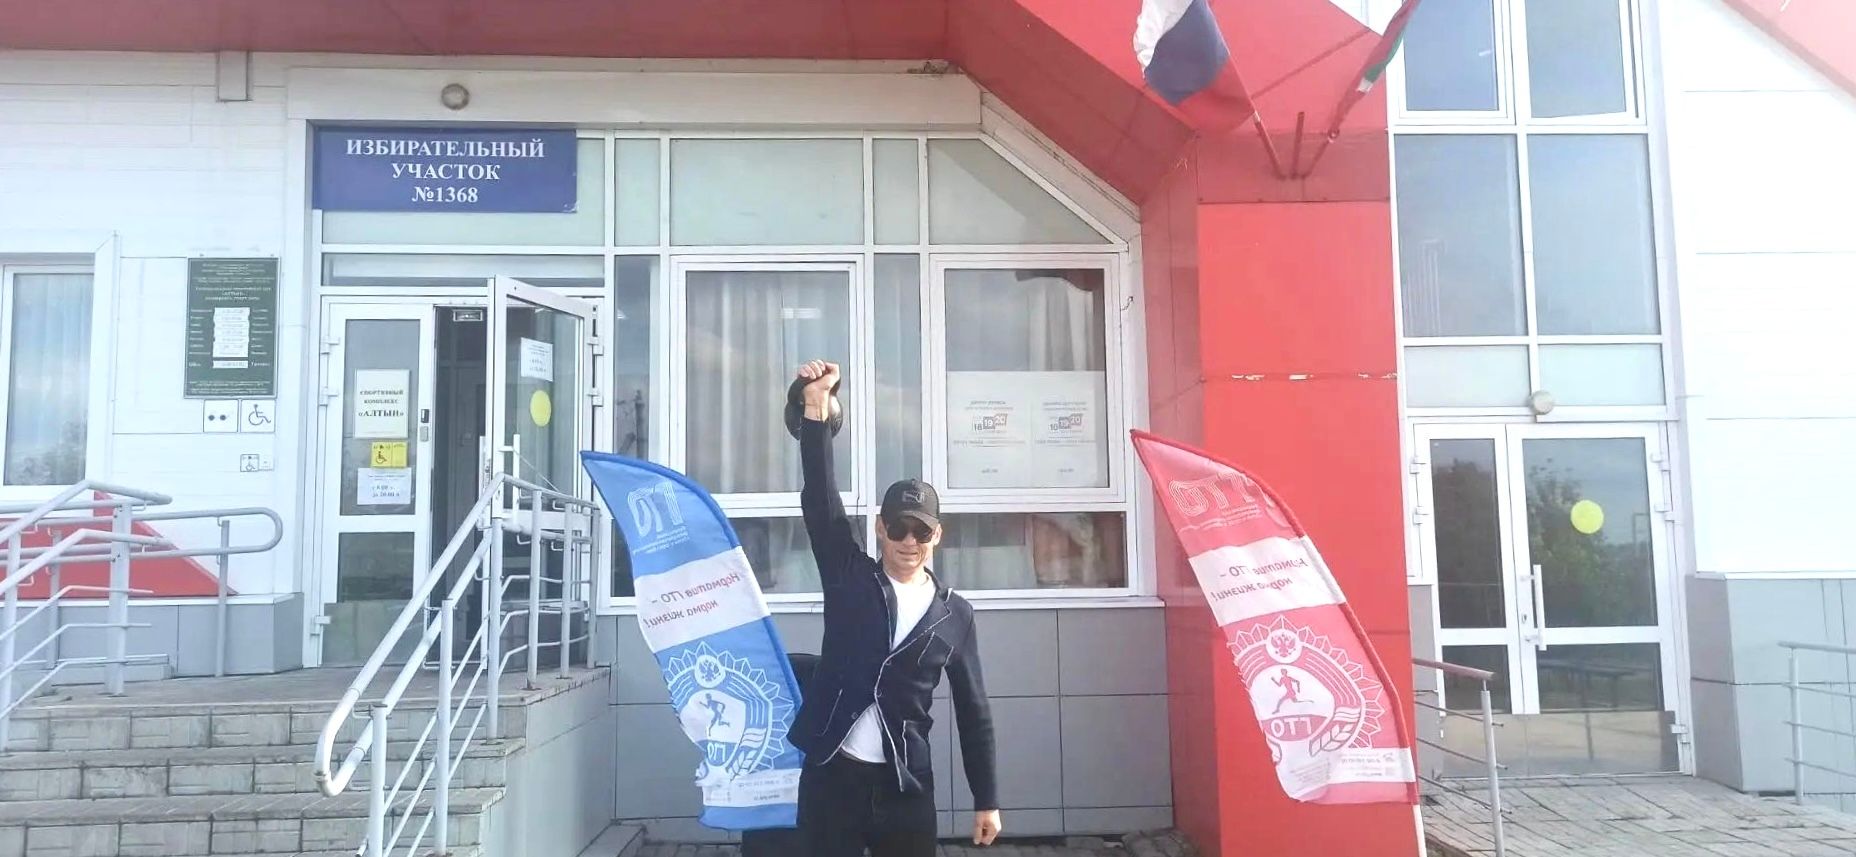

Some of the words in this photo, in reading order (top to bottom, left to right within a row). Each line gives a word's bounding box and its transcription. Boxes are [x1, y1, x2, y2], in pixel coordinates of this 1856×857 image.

[346, 138, 545, 158] ИЗБИРАТЕЛЬНЫЙ
[392, 162, 501, 180] УЧАСТОК
[411, 186, 478, 203] №1368
[358, 409, 404, 417] «АЛТЫН»
